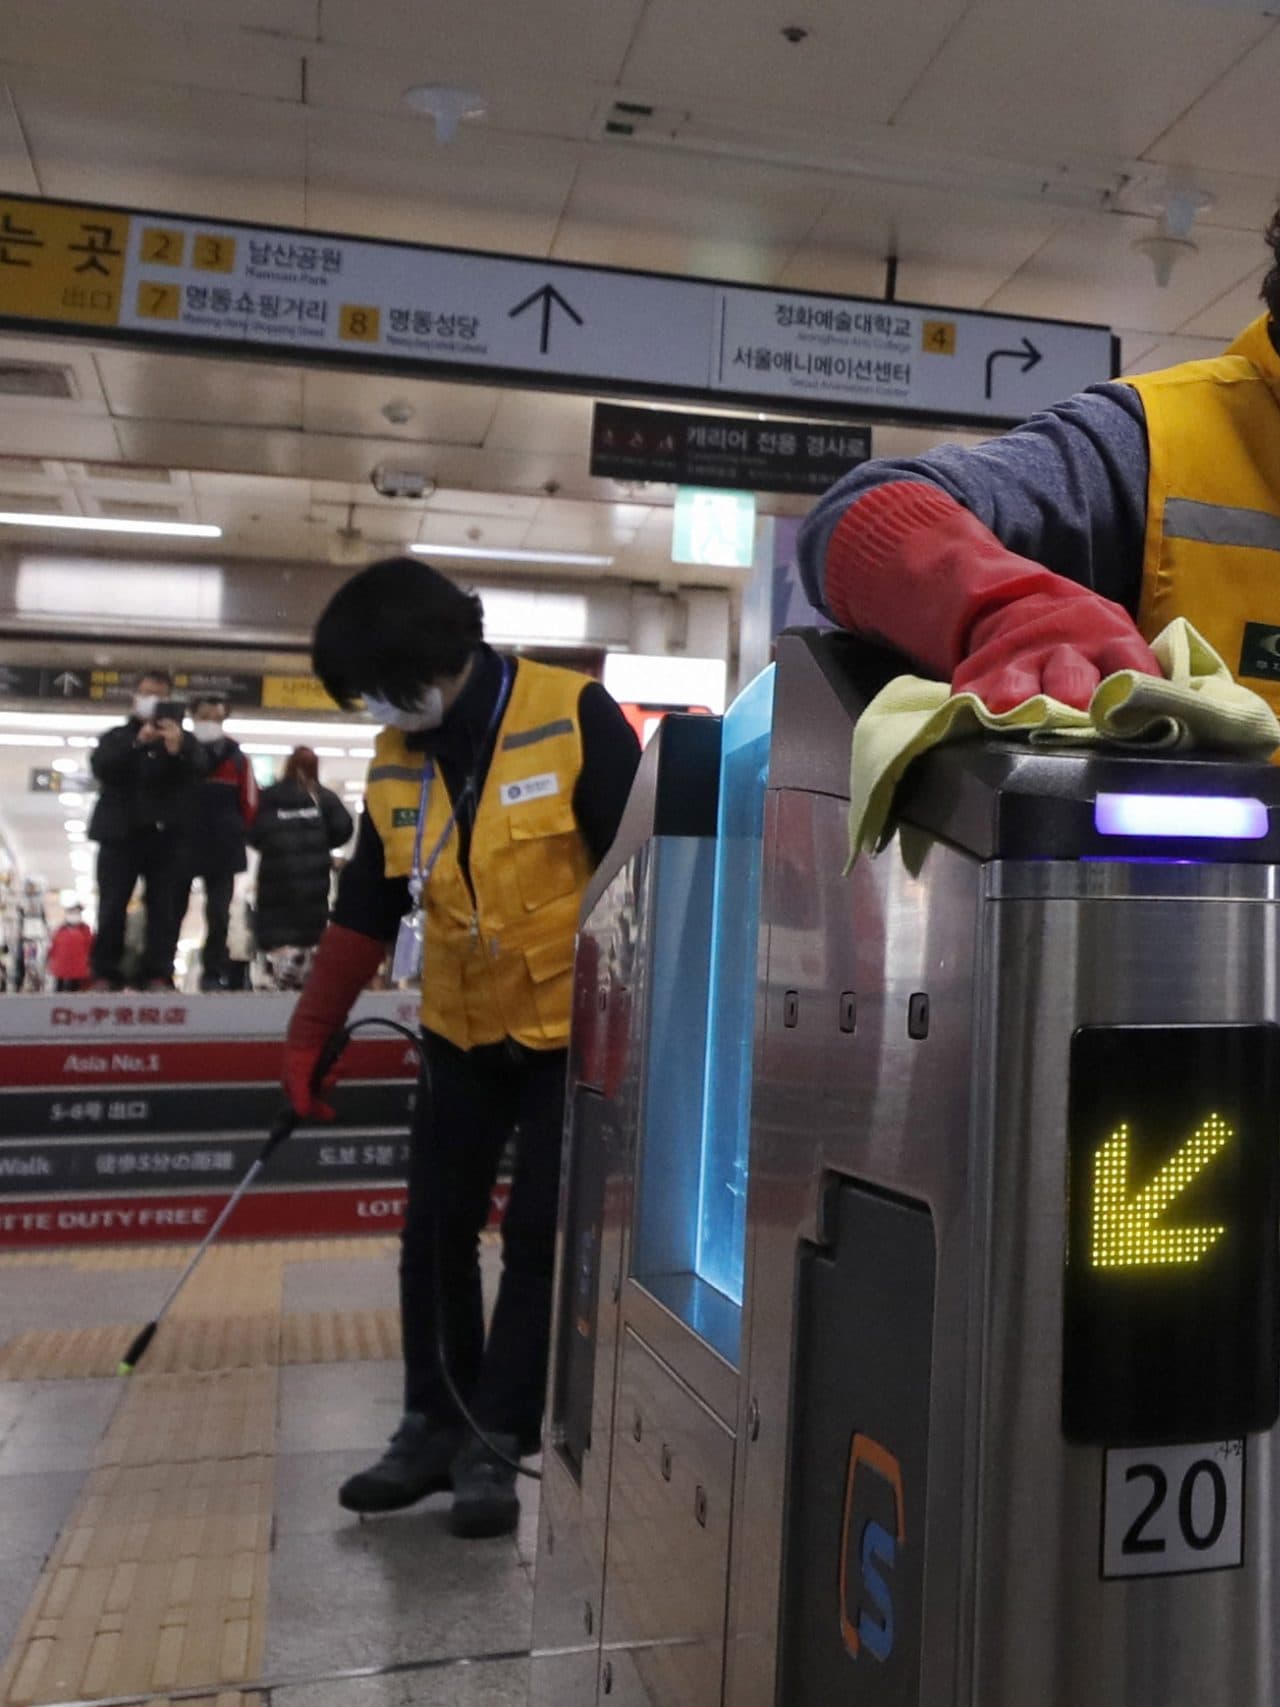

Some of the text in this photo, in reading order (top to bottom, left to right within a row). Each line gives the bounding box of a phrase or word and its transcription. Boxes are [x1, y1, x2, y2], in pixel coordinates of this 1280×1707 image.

[67, 223, 122, 277] 곳
[150, 233, 223, 265] 2 3
[248, 239, 342, 274] 남산공원
[149, 286, 169, 313] 7
[184, 284, 328, 323] 명동쇼핑거리
[349, 312, 369, 337] 8
[389, 306, 480, 340] 명동성당
[774, 303, 912, 338] 정화예술대학교
[929, 326, 946, 350] 4
[732, 345, 911, 384] 서울애니메이션센터
[63, 1053, 162, 1073] Asia No.1
[57, 1210, 136, 1230] DUTY
[138, 1207, 209, 1226] FREE
[357, 1200, 409, 1218] LOT
[1121, 1458, 1228, 1556] 20
